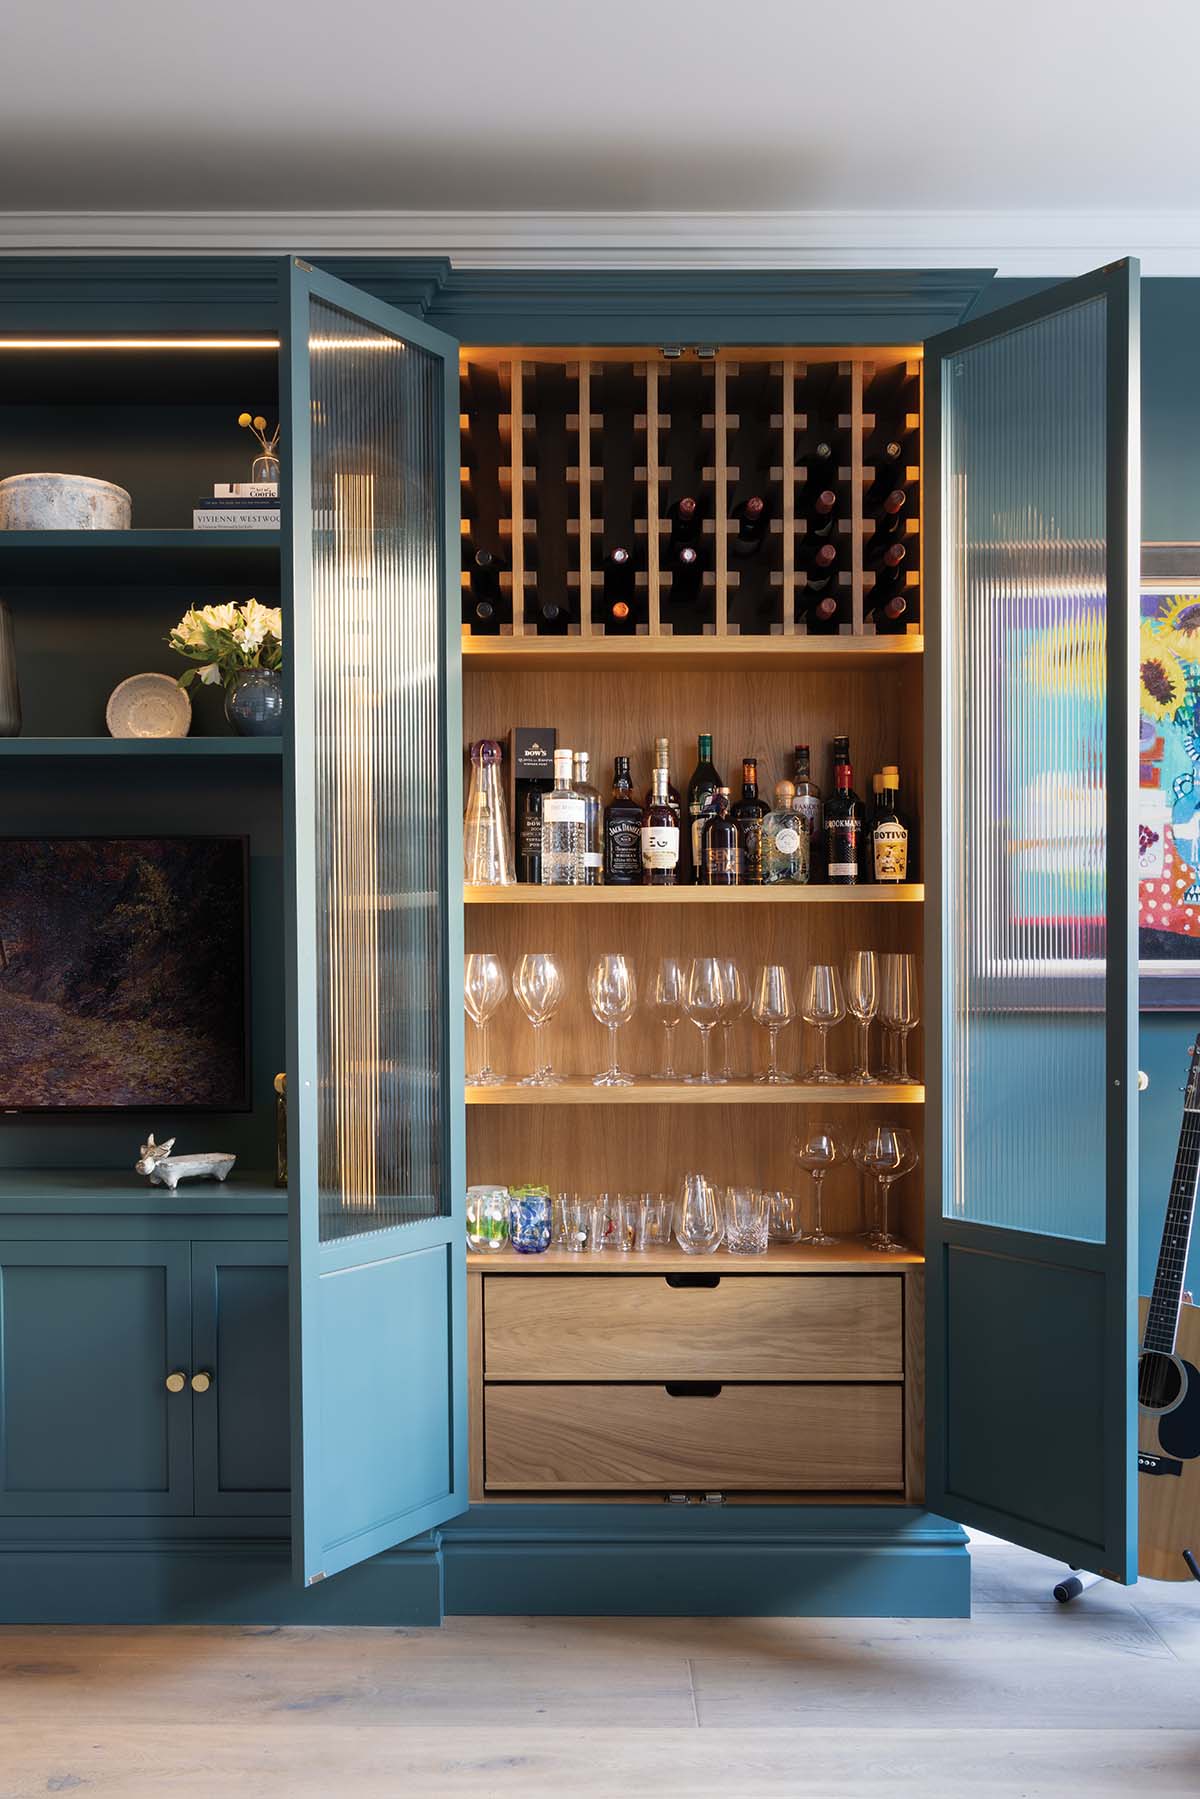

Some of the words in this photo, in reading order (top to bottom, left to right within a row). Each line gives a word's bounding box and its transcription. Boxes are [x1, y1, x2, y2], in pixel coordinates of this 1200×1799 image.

[197, 515, 236, 523] VIVIENNE
[825, 819, 862, 828] BROCKMANS
[608, 825, 622, 836] JACK
[874, 831, 907, 840] BOTIVO
